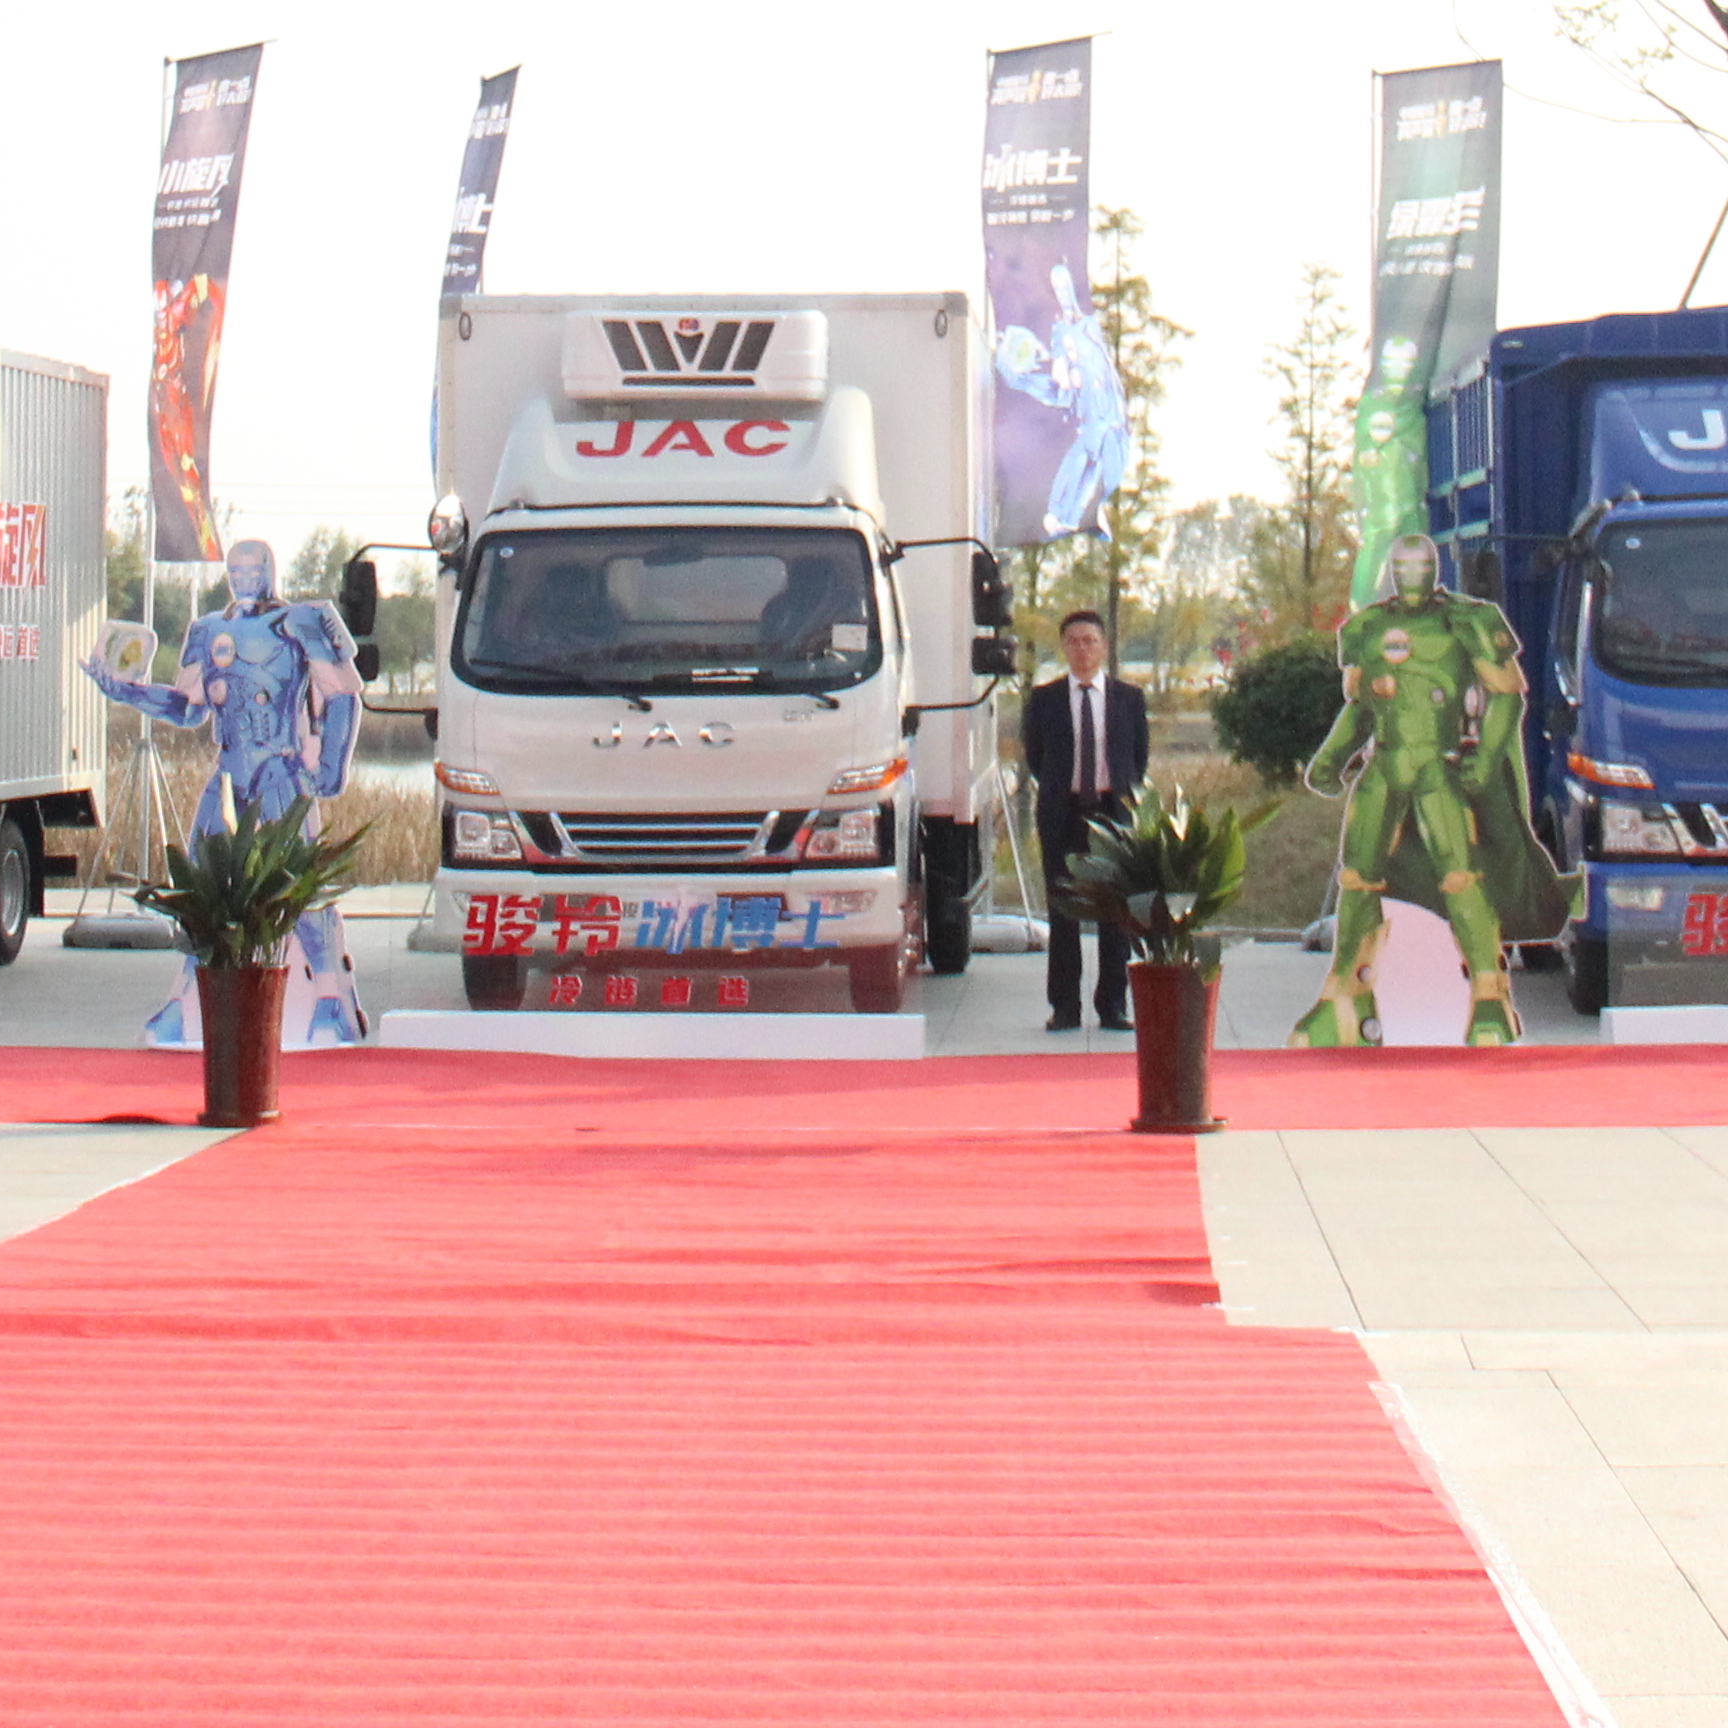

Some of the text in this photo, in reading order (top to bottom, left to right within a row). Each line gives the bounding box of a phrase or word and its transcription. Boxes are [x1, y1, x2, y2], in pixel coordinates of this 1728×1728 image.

[982, 143, 1083, 193] 冰博士
[576, 420, 791, 458] JAC
[592, 720, 737, 748] JAC
[463, 893, 847, 956] 骏铃冰博士
